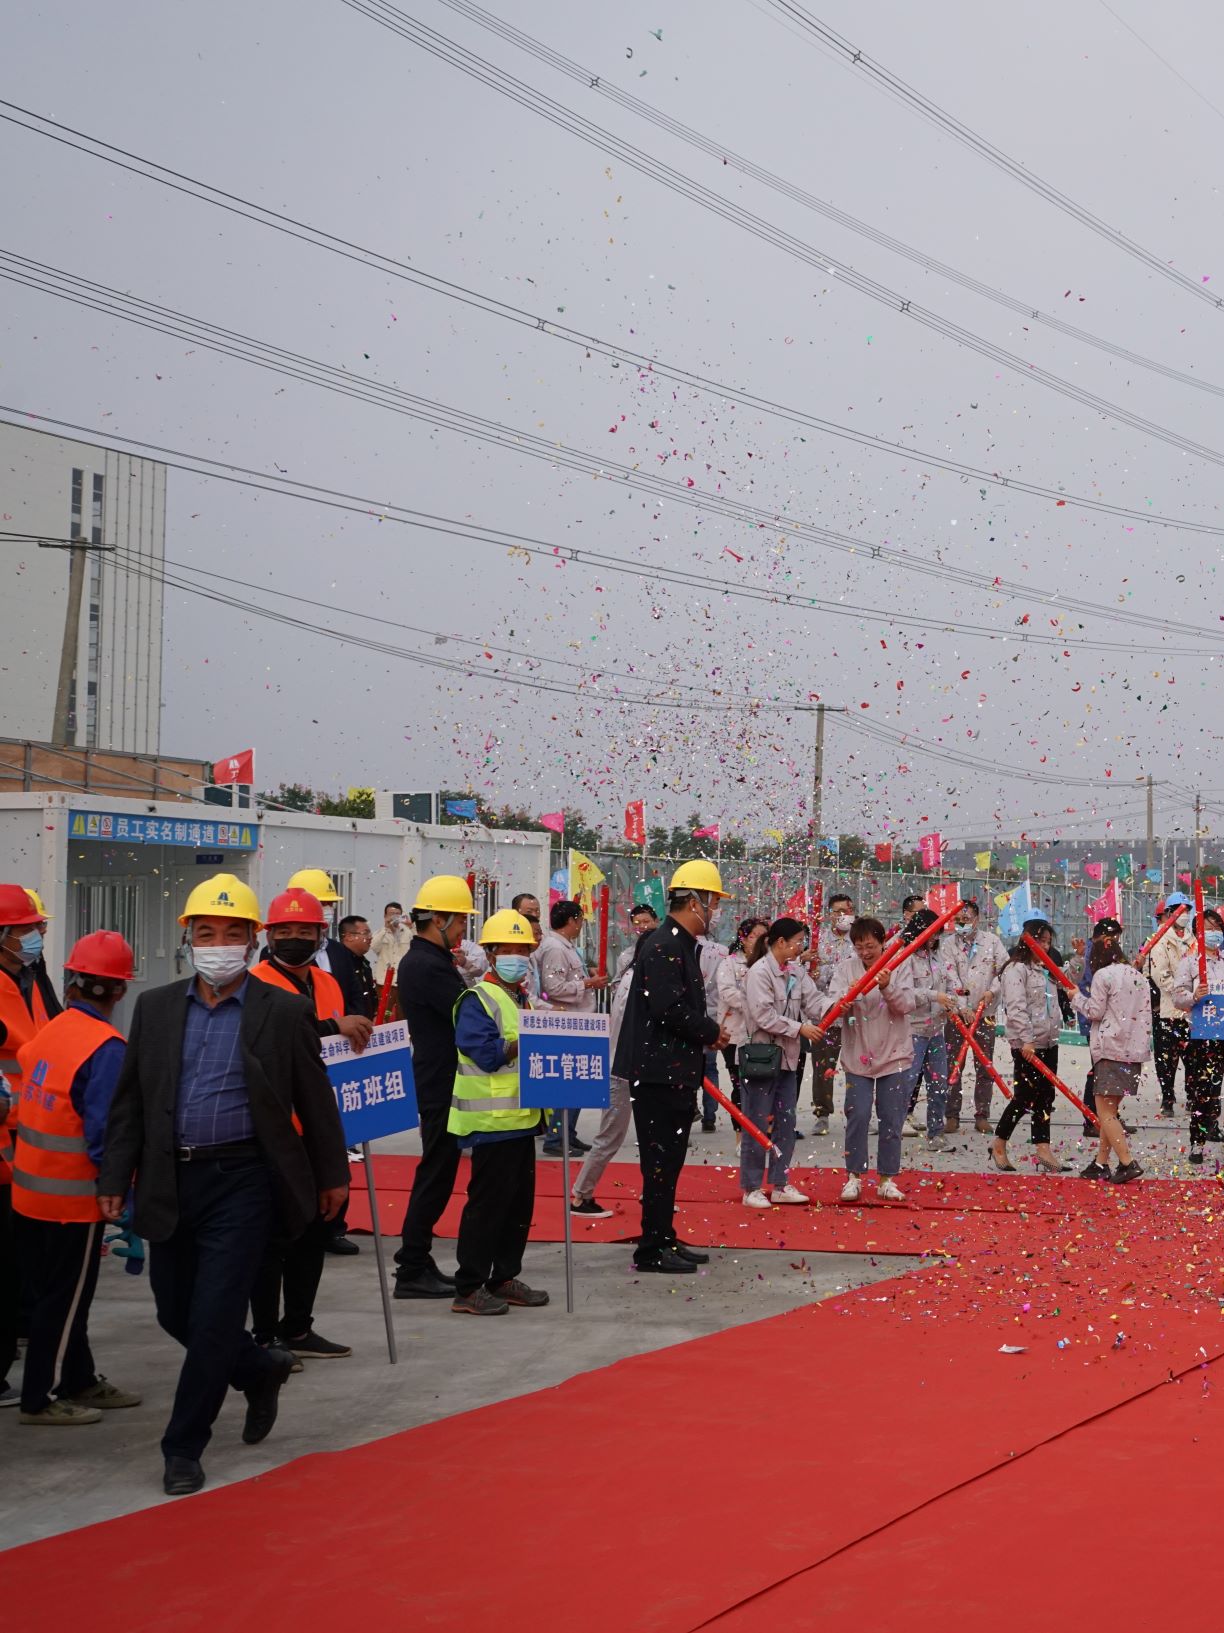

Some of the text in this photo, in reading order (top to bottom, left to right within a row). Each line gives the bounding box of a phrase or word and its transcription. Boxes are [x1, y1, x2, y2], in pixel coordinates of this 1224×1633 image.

[116, 817, 215, 844] 员工实名制通道
[528, 1052, 604, 1081] 施工管理组
[332, 1070, 406, 1113] 筋班组
